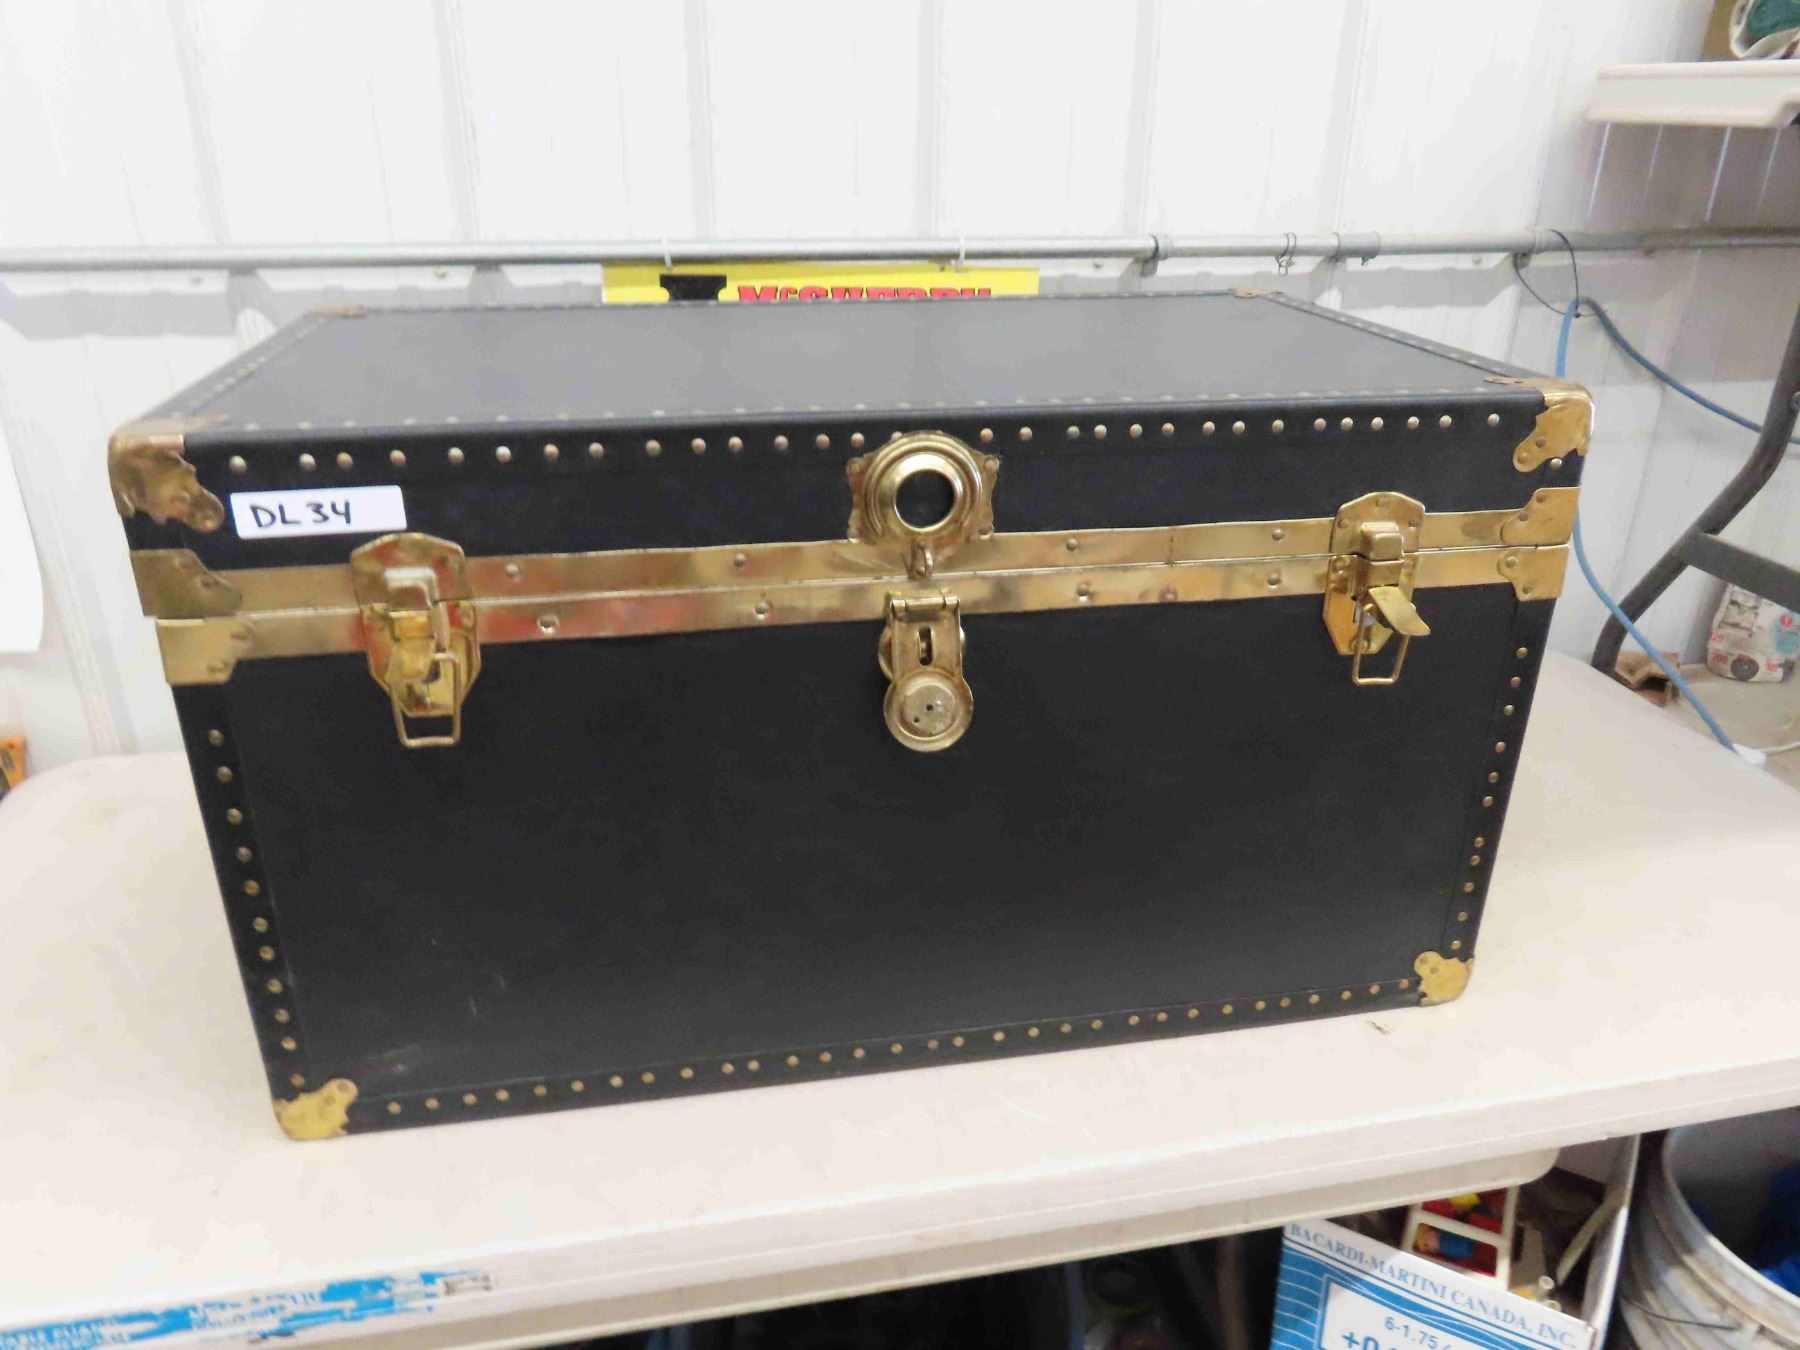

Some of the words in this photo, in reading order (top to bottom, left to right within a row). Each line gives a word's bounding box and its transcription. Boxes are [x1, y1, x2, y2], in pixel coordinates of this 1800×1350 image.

[250, 503, 301, 528] DL
[305, 499, 352, 525] 34
[1290, 1222, 1448, 1299] BACARDI-MARTINI
[1538, 1322, 1577, 1349] INC.
